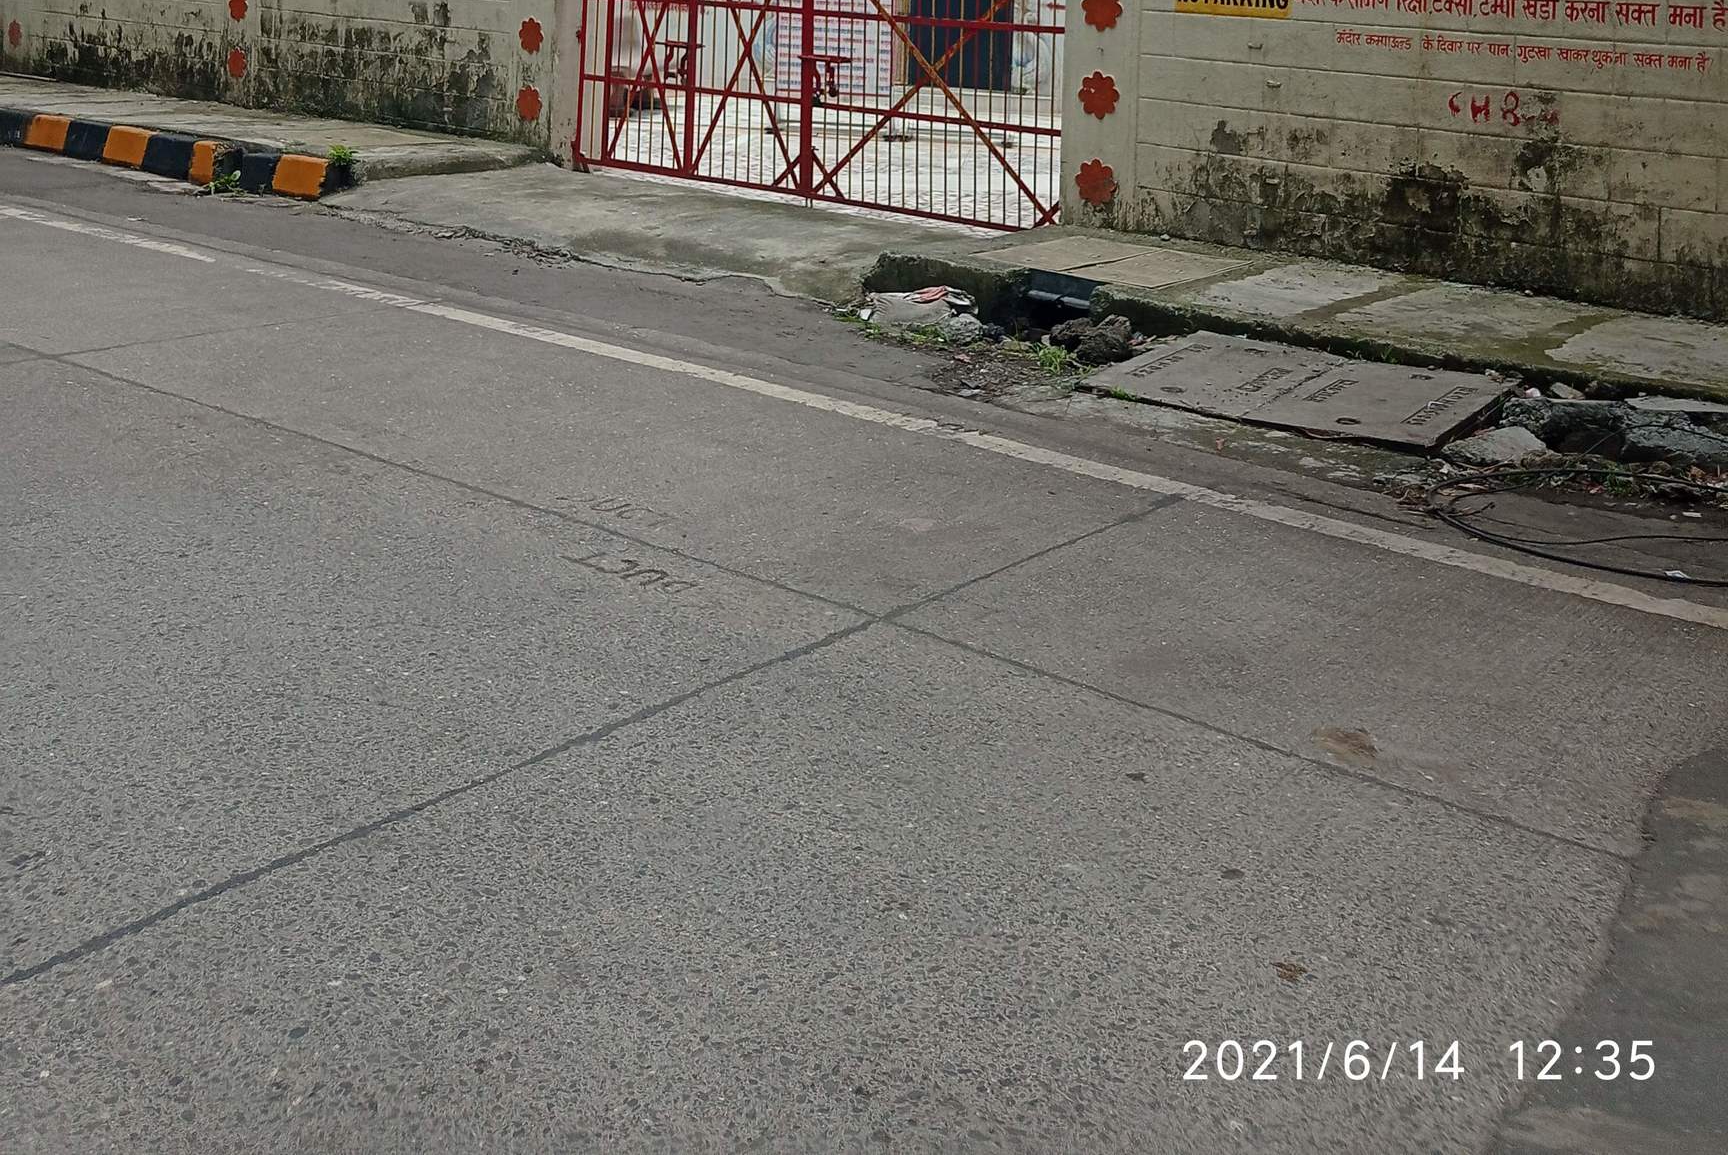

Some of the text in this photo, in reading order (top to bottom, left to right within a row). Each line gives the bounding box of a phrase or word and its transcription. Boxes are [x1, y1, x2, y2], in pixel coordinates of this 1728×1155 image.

[1565, 0, 1610, 24] करना
[1615, 1, 1661, 27] सक्त
[1668, 4, 1707, 29] मना
[1422, 35, 1436, 52] के
[1467, 41, 1482, 55] पर
[1668, 55, 1693, 71] मना
